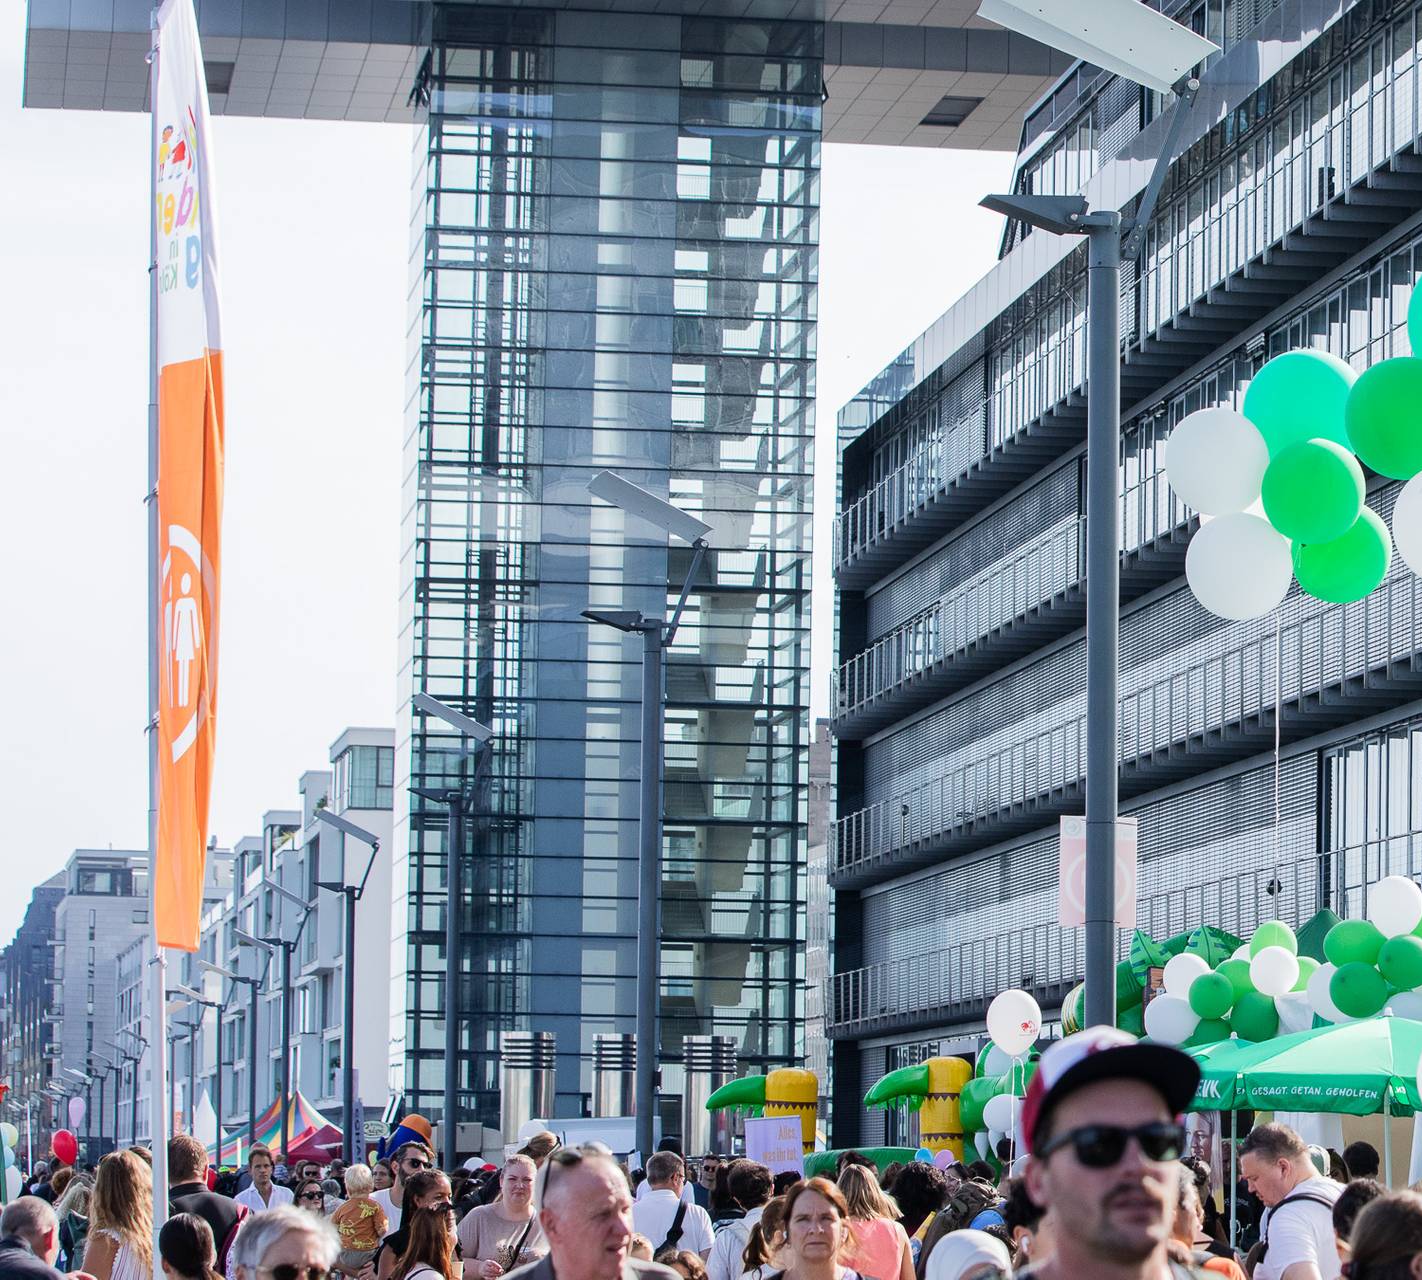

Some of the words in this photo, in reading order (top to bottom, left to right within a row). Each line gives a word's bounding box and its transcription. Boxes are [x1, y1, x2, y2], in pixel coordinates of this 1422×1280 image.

[1195, 1079, 1221, 1099] EVK
[1251, 1086, 1288, 1096] GESAGT.
[1291, 1086, 1323, 1096] GETAN.
[1325, 1087, 1380, 1099] GEHOLFEN.
